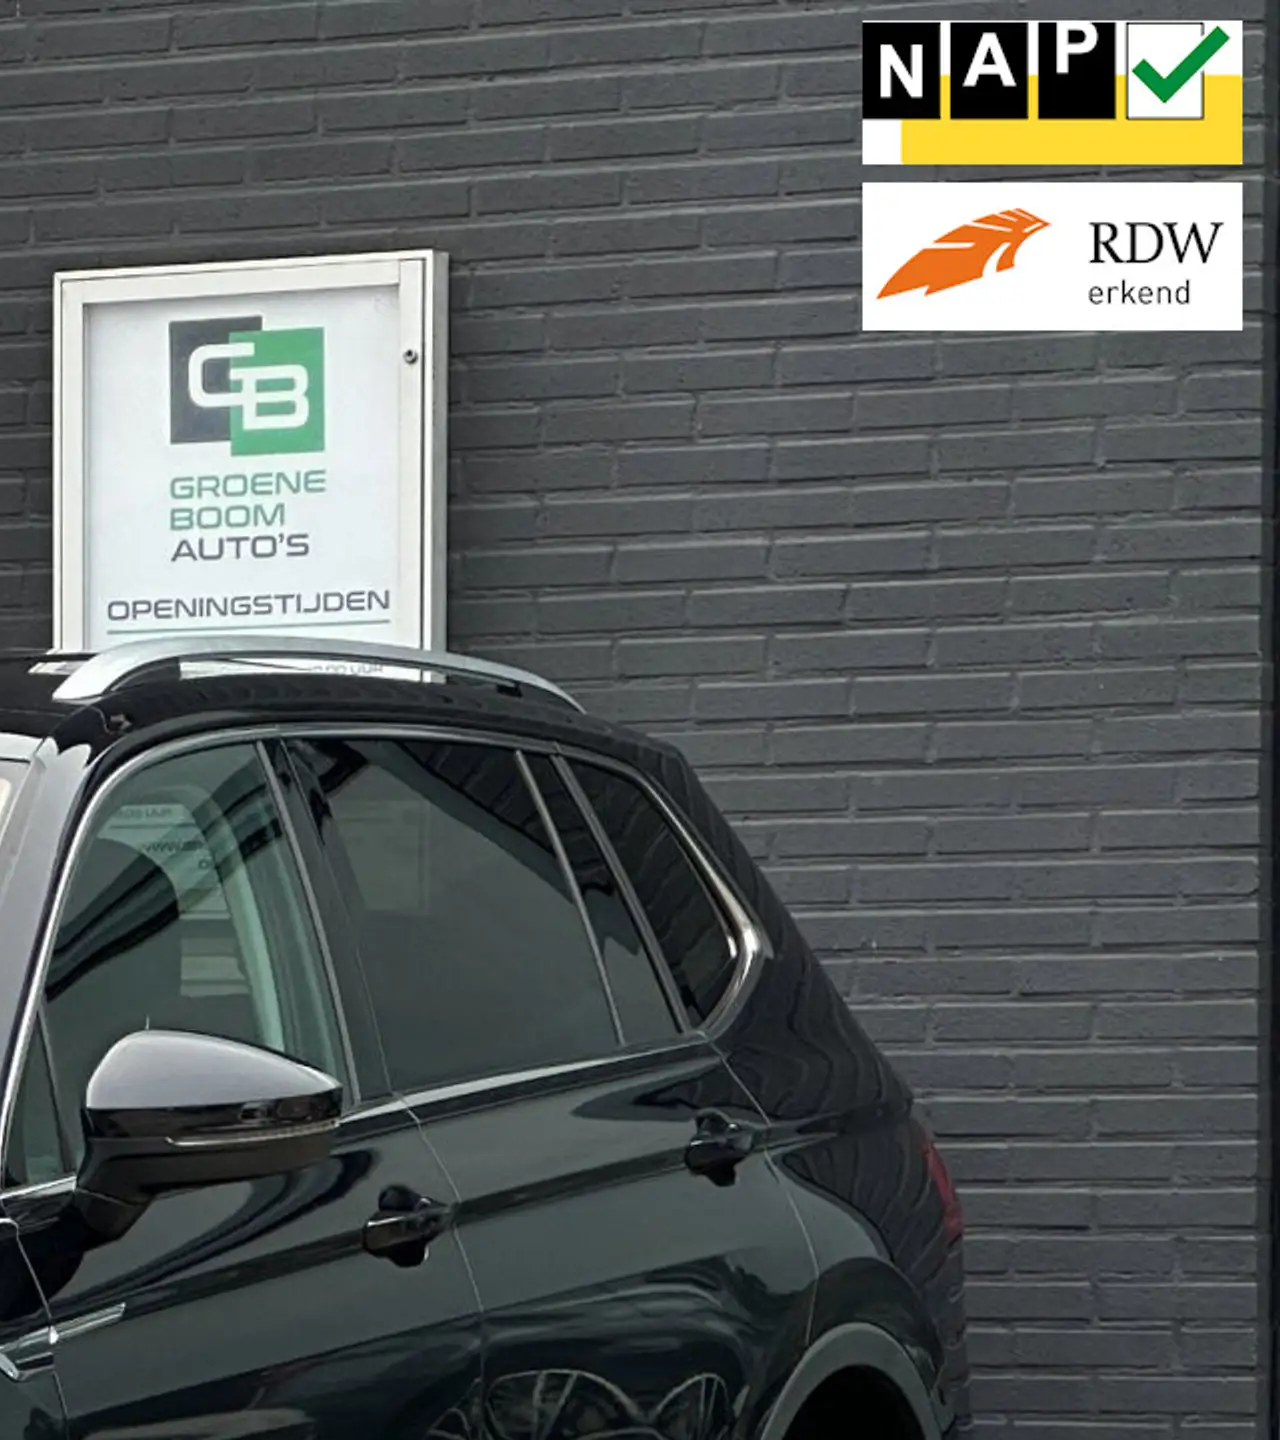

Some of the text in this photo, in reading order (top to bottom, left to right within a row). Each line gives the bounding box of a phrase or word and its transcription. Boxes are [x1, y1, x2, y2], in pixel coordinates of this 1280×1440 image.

[170, 469, 327, 499] GROENE
[170, 503, 285, 531] BOOM
[171, 533, 309, 562] AUTO'S
[107, 590, 390, 621] OPENINGSTIJDEN
